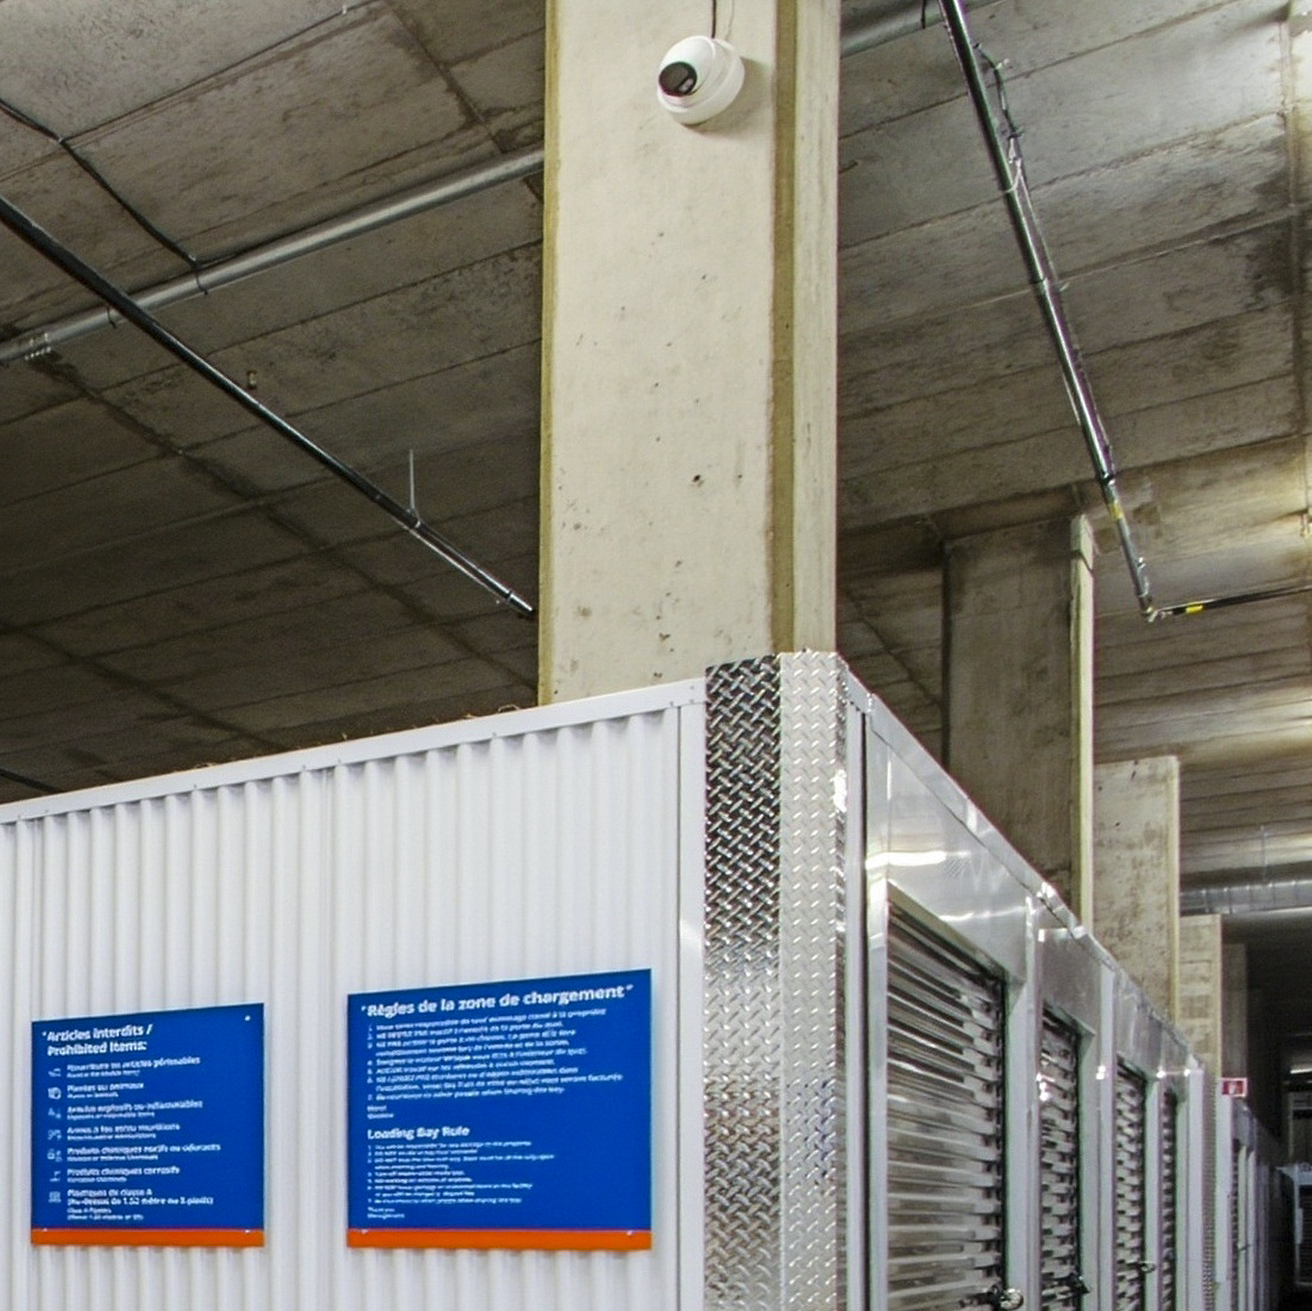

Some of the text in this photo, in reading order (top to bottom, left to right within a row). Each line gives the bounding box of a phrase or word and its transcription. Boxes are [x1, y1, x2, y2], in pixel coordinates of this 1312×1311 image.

[418, 999, 437, 1013] de
[440, 997, 456, 1011] la
[458, 996, 496, 1010] zone
[499, 993, 520, 1007] de
[93, 1024, 144, 1039] interdits
[47, 1041, 147, 1057] Prohibited Items:
[367, 1127, 415, 1140] Loading
[416, 1127, 440, 1139] Bay
